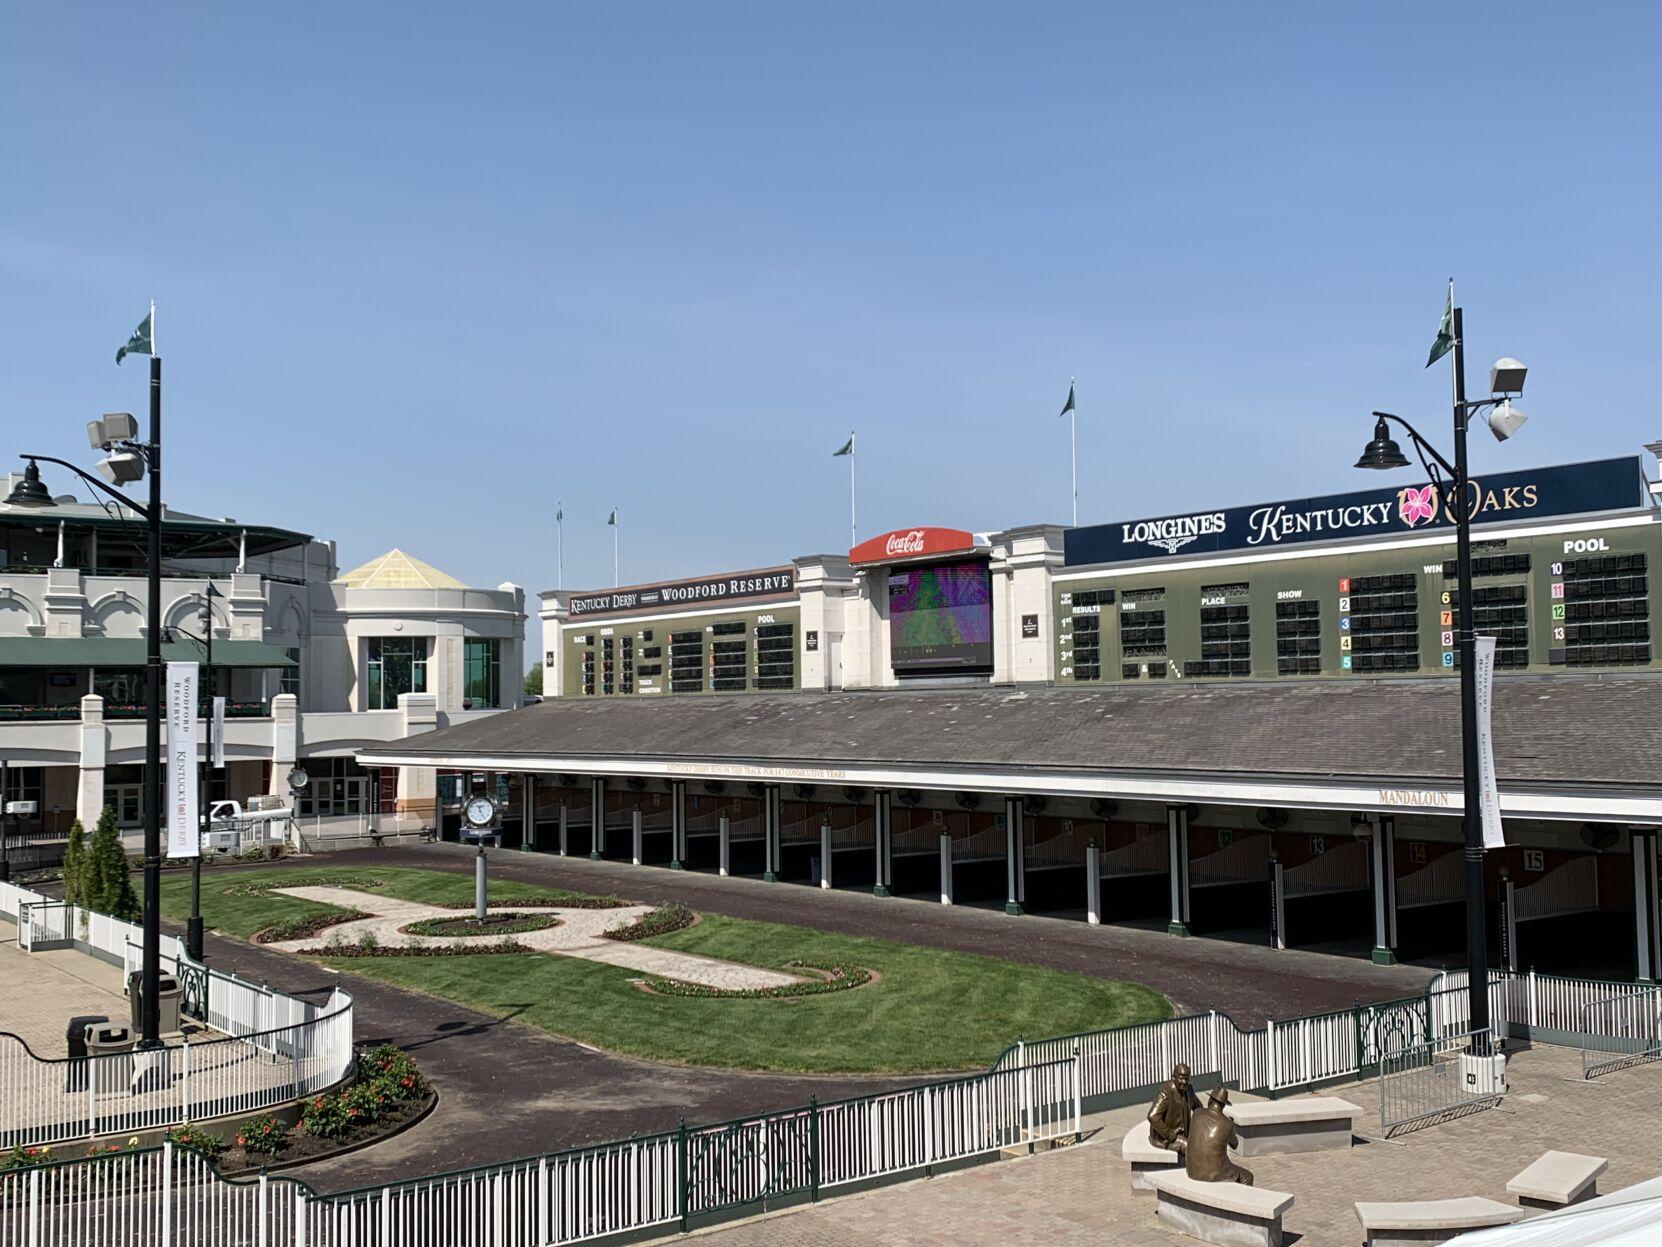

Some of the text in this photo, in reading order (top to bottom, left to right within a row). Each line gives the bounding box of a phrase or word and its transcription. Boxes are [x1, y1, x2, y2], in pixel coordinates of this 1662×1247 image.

[1122, 513, 1226, 543] LONGINES
[1246, 502, 1392, 544] KENTUCKY
[1563, 538, 1610, 554] POOL
[1423, 565, 1443, 574] WIN
[1551, 562, 1563, 575] 10
[661, 575, 789, 601] WOODFORD RESERVE
[1553, 585, 1563, 597] 11
[1277, 590, 1302, 600] SHOW
[1441, 592, 1450, 604] 6
[571, 597, 610, 613] KENTUCKY
[612, 594, 637, 608] DERBY
[1122, 602, 1136, 610] WIN
[1201, 597, 1226, 606] PLACE
[1072, 605, 1101, 614] RESULTS
[1553, 606, 1564, 618] 12
[757, 614, 775, 624] POOL
[1061, 617, 1072, 628] 1st
[1443, 613, 1450, 623] 7
[1060, 633, 1072, 645] 2nd
[1444, 633, 1451, 644] 8
[1554, 628, 1564, 640] 13
[1060, 650, 1073, 661] 3rd
[1445, 654, 1452, 664] 9
[1061, 667, 1073, 676] 4th
[173, 682, 181, 728] RESERVE
[183, 676, 191, 733] WOODFORD
[176, 751, 186, 803] KENTUCKY
[1379, 790, 1449, 806] MANDALOUN
[1312, 837, 1325, 854] 13
[1526, 852, 1542, 869] 15
